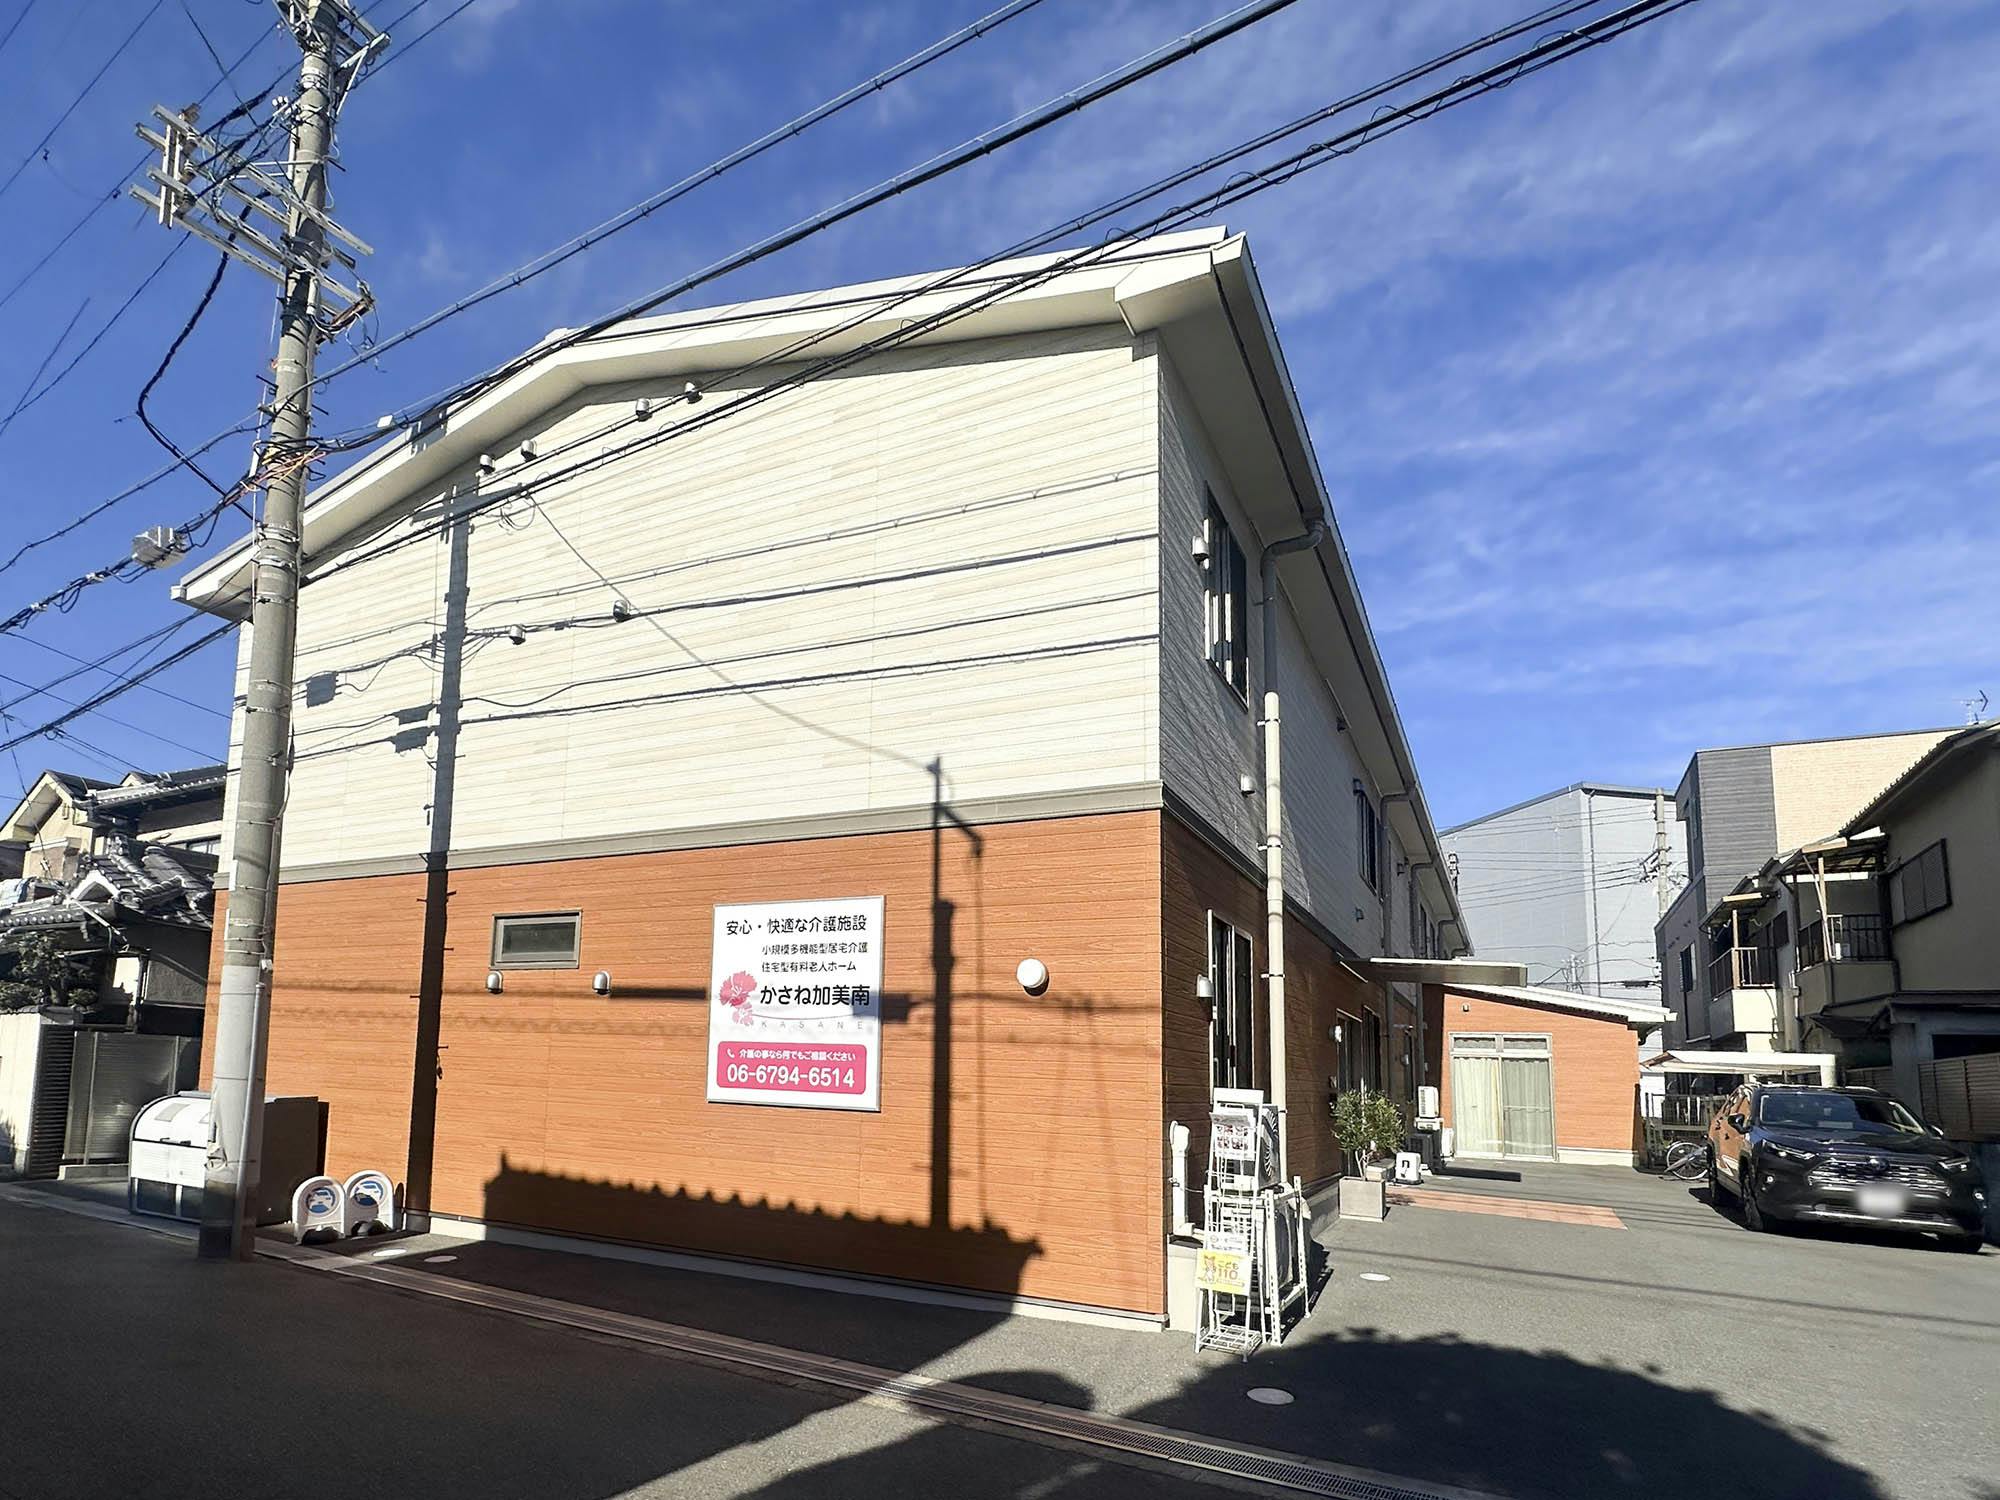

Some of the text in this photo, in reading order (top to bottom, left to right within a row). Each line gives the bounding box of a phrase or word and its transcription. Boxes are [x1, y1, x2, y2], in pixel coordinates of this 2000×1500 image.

[726, 914, 867, 935] 安心・快適な介護施設
[762, 942, 868, 955] 小規模多機能型居宅介護
[762, 961, 857, 973] 住宅型有料老人ホーム
[760, 984, 871, 1006] かさね加美南
[761, 1020, 864, 1030] KASANE
[727, 1063, 855, 1088] 06-6794-6514
